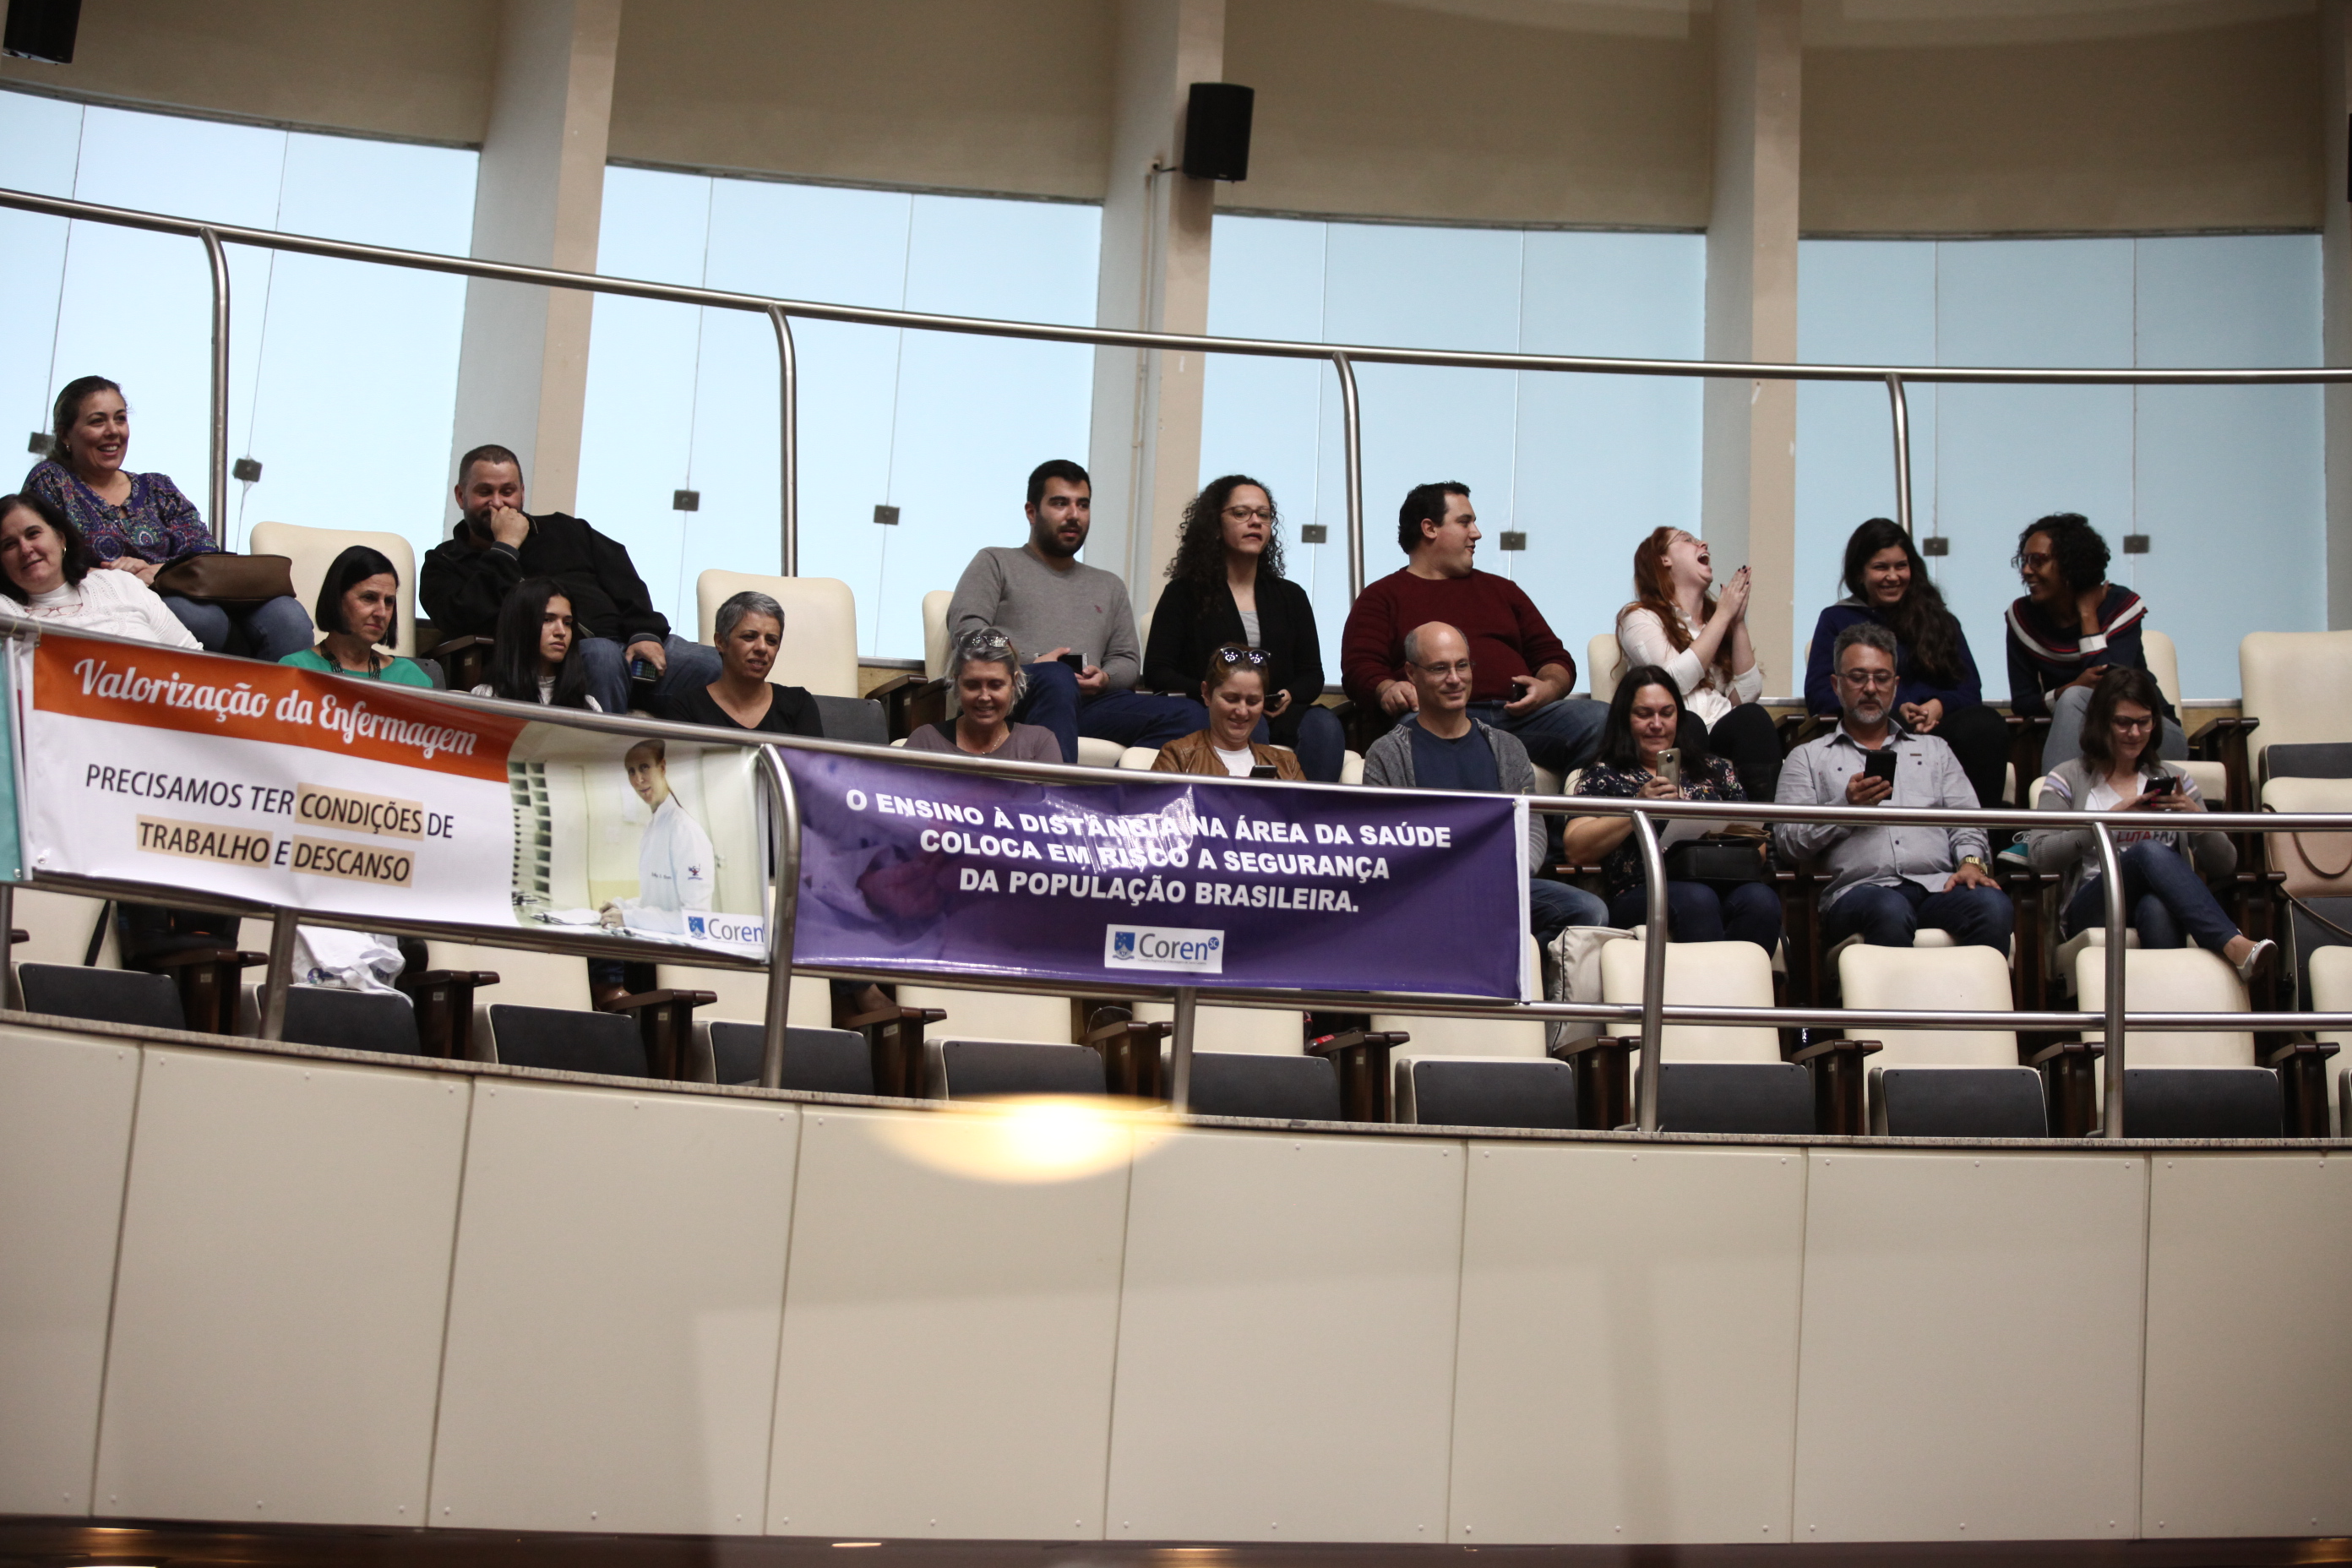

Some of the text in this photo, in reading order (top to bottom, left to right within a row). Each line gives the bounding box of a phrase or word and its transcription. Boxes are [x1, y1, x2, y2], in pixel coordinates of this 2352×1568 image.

[74, 658, 477, 760] Valorização da Enfermagem
[85, 763, 455, 839] PRECISAMOS TER CONDIÇÕES DE
[846, 789, 868, 811] O
[875, 792, 984, 825] ENSINO
[994, 806, 1015, 830] À
[1188, 815, 1228, 839] NA
[1234, 814, 1309, 843] ÁREA
[1315, 824, 1354, 845] DA
[1359, 821, 1451, 848] SAÚDE
[139, 821, 411, 882] TRABALHO E DESCANSO
[920, 829, 1390, 884] COLOCA EM RISCO A SEGURANÇA
[960, 868, 1359, 912] DA POPULAÇÃO BRASILEIRA.
[708, 917, 765, 944] Coren
[1139, 933, 1208, 961] Coren
